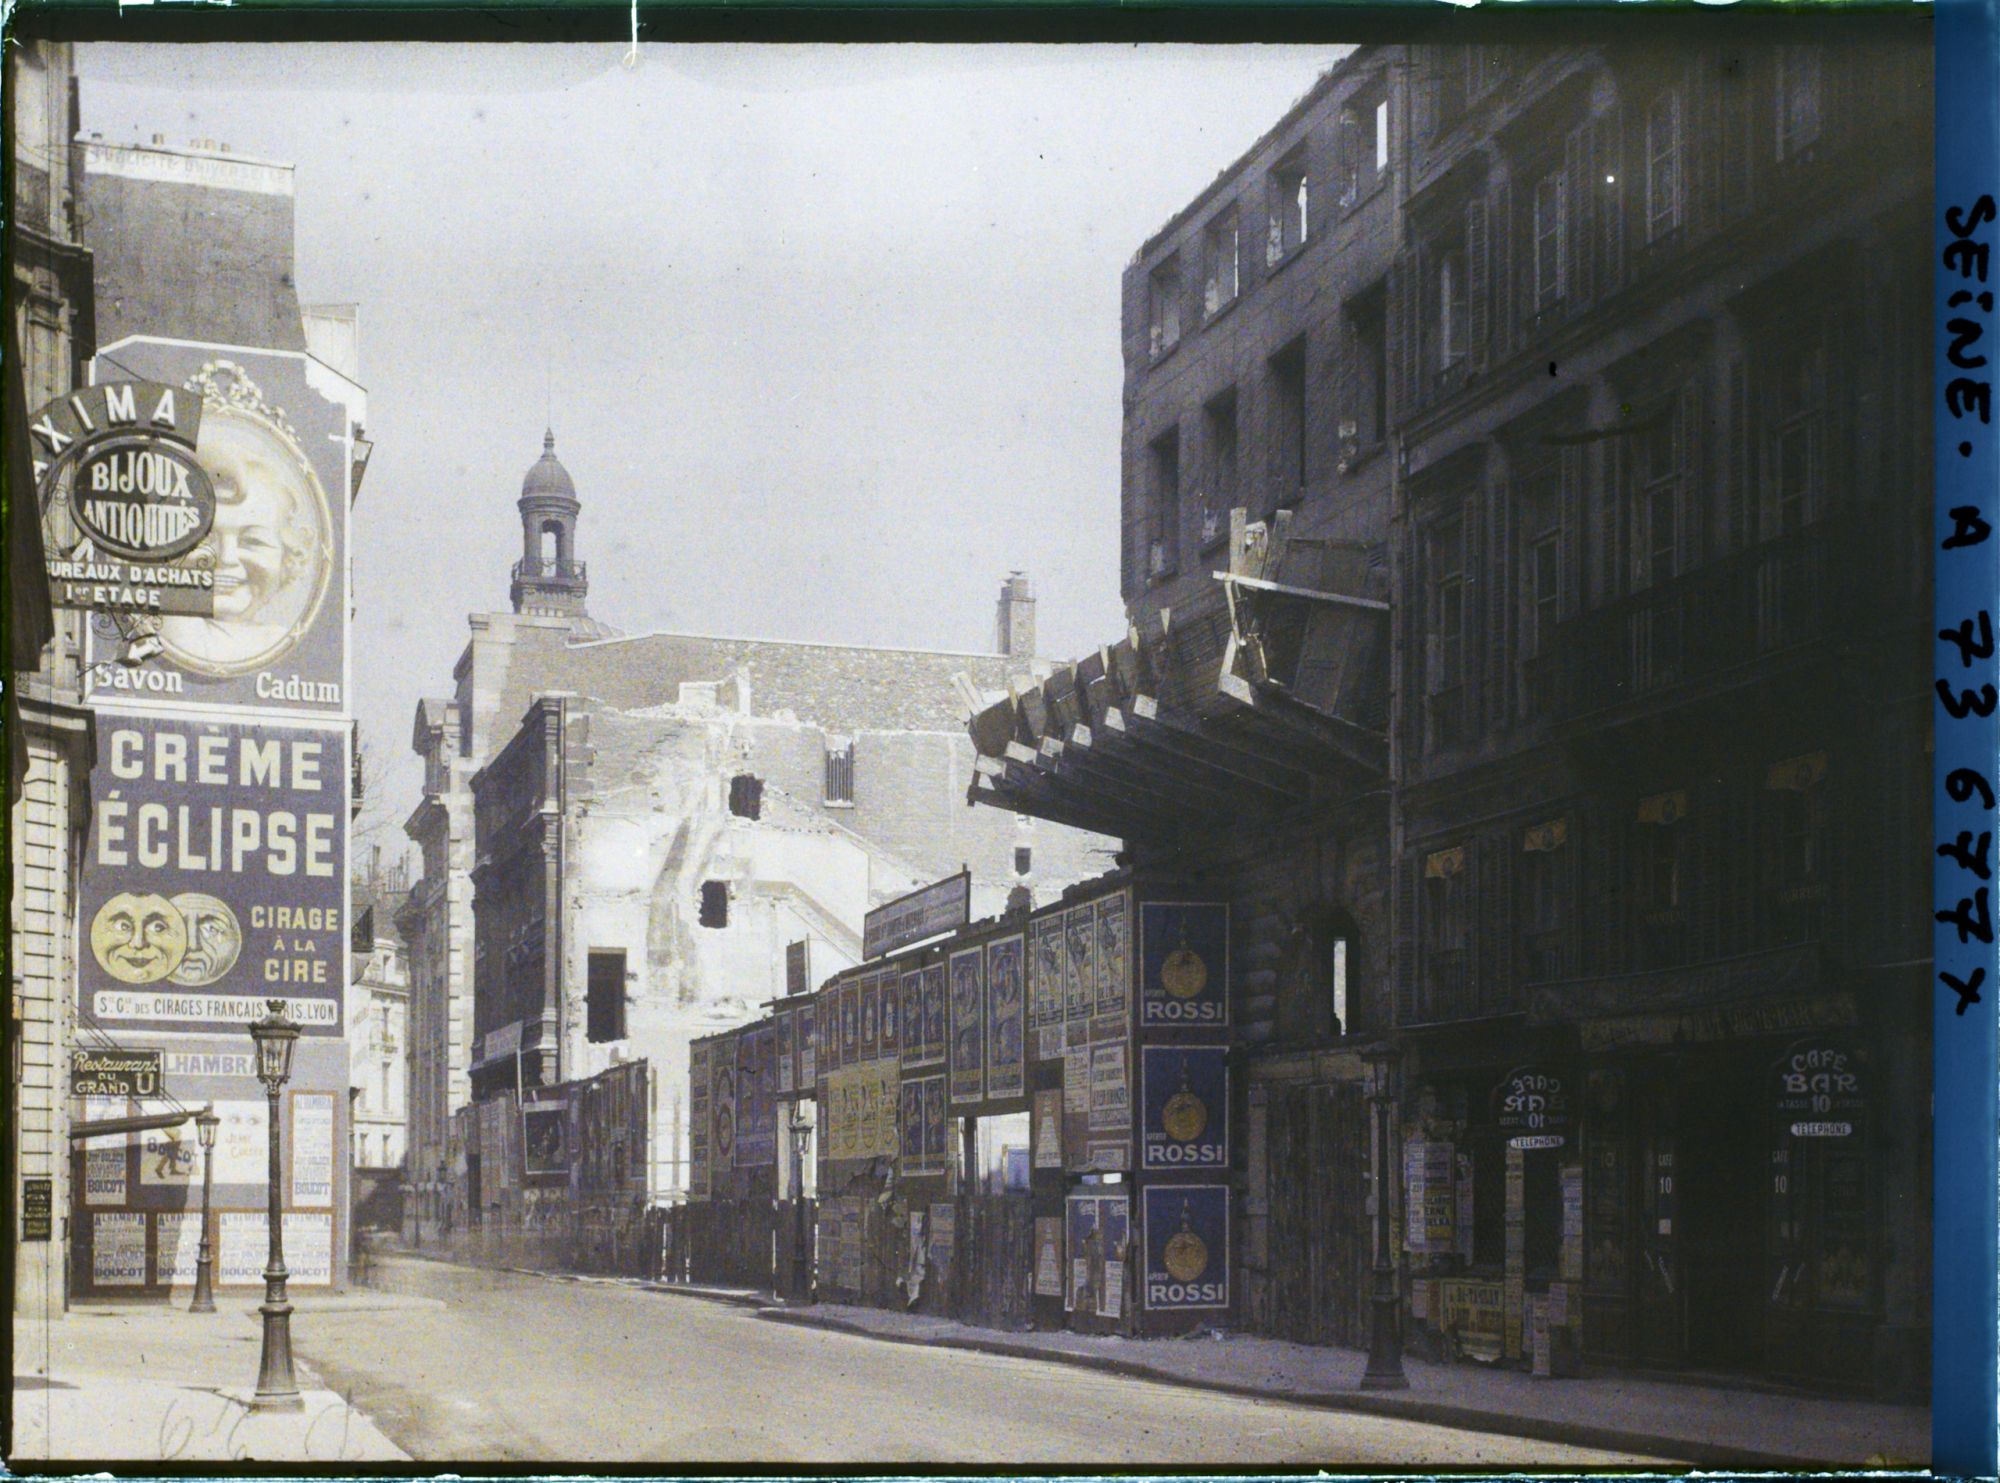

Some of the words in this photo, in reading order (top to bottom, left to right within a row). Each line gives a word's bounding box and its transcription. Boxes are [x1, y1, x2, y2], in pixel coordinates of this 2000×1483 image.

[91, 451, 193, 499] BIJOUX
[1940, 505, 1993, 550] A
[129, 565, 213, 587] D'ACHATS
[93, 585, 161, 607] ETAGE
[1934, 610, 1998, 719] 73
[96, 665, 183, 694] Savon
[255, 671, 341, 704] Cadum
[110, 725, 323, 791] CRÈME
[97, 790, 335, 877] ÉCLIPSE
[250, 905, 339, 932] CIRAGE
[294, 939, 317, 953] LA
[264, 959, 328, 983] CIRE
[135, 1003, 150, 1015] DES
[154, 998, 204, 1016] CIRAGES
[307, 1003, 335, 1020] LYON
[1146, 1001, 1223, 1020] ROSSI
[73, 1051, 160, 1073] Restaurant
[75, 1081, 130, 1095] GRAND
[1781, 1073, 1858, 1094] BAR
[1811, 1094, 1832, 1113] 10
[1796, 1122, 1848, 1135] TELEPHONE
[1148, 1144, 1223, 1163] ROSSI
[87, 1179, 126, 1194] BOUCOT
[294, 1182, 331, 1195] BOUCOT
[1659, 1176, 1673, 1195] 10
[1774, 1175, 1789, 1194] 10
[94, 1267, 146, 1277] BOUCOT
[1150, 1283, 1224, 1303] ROSSI
